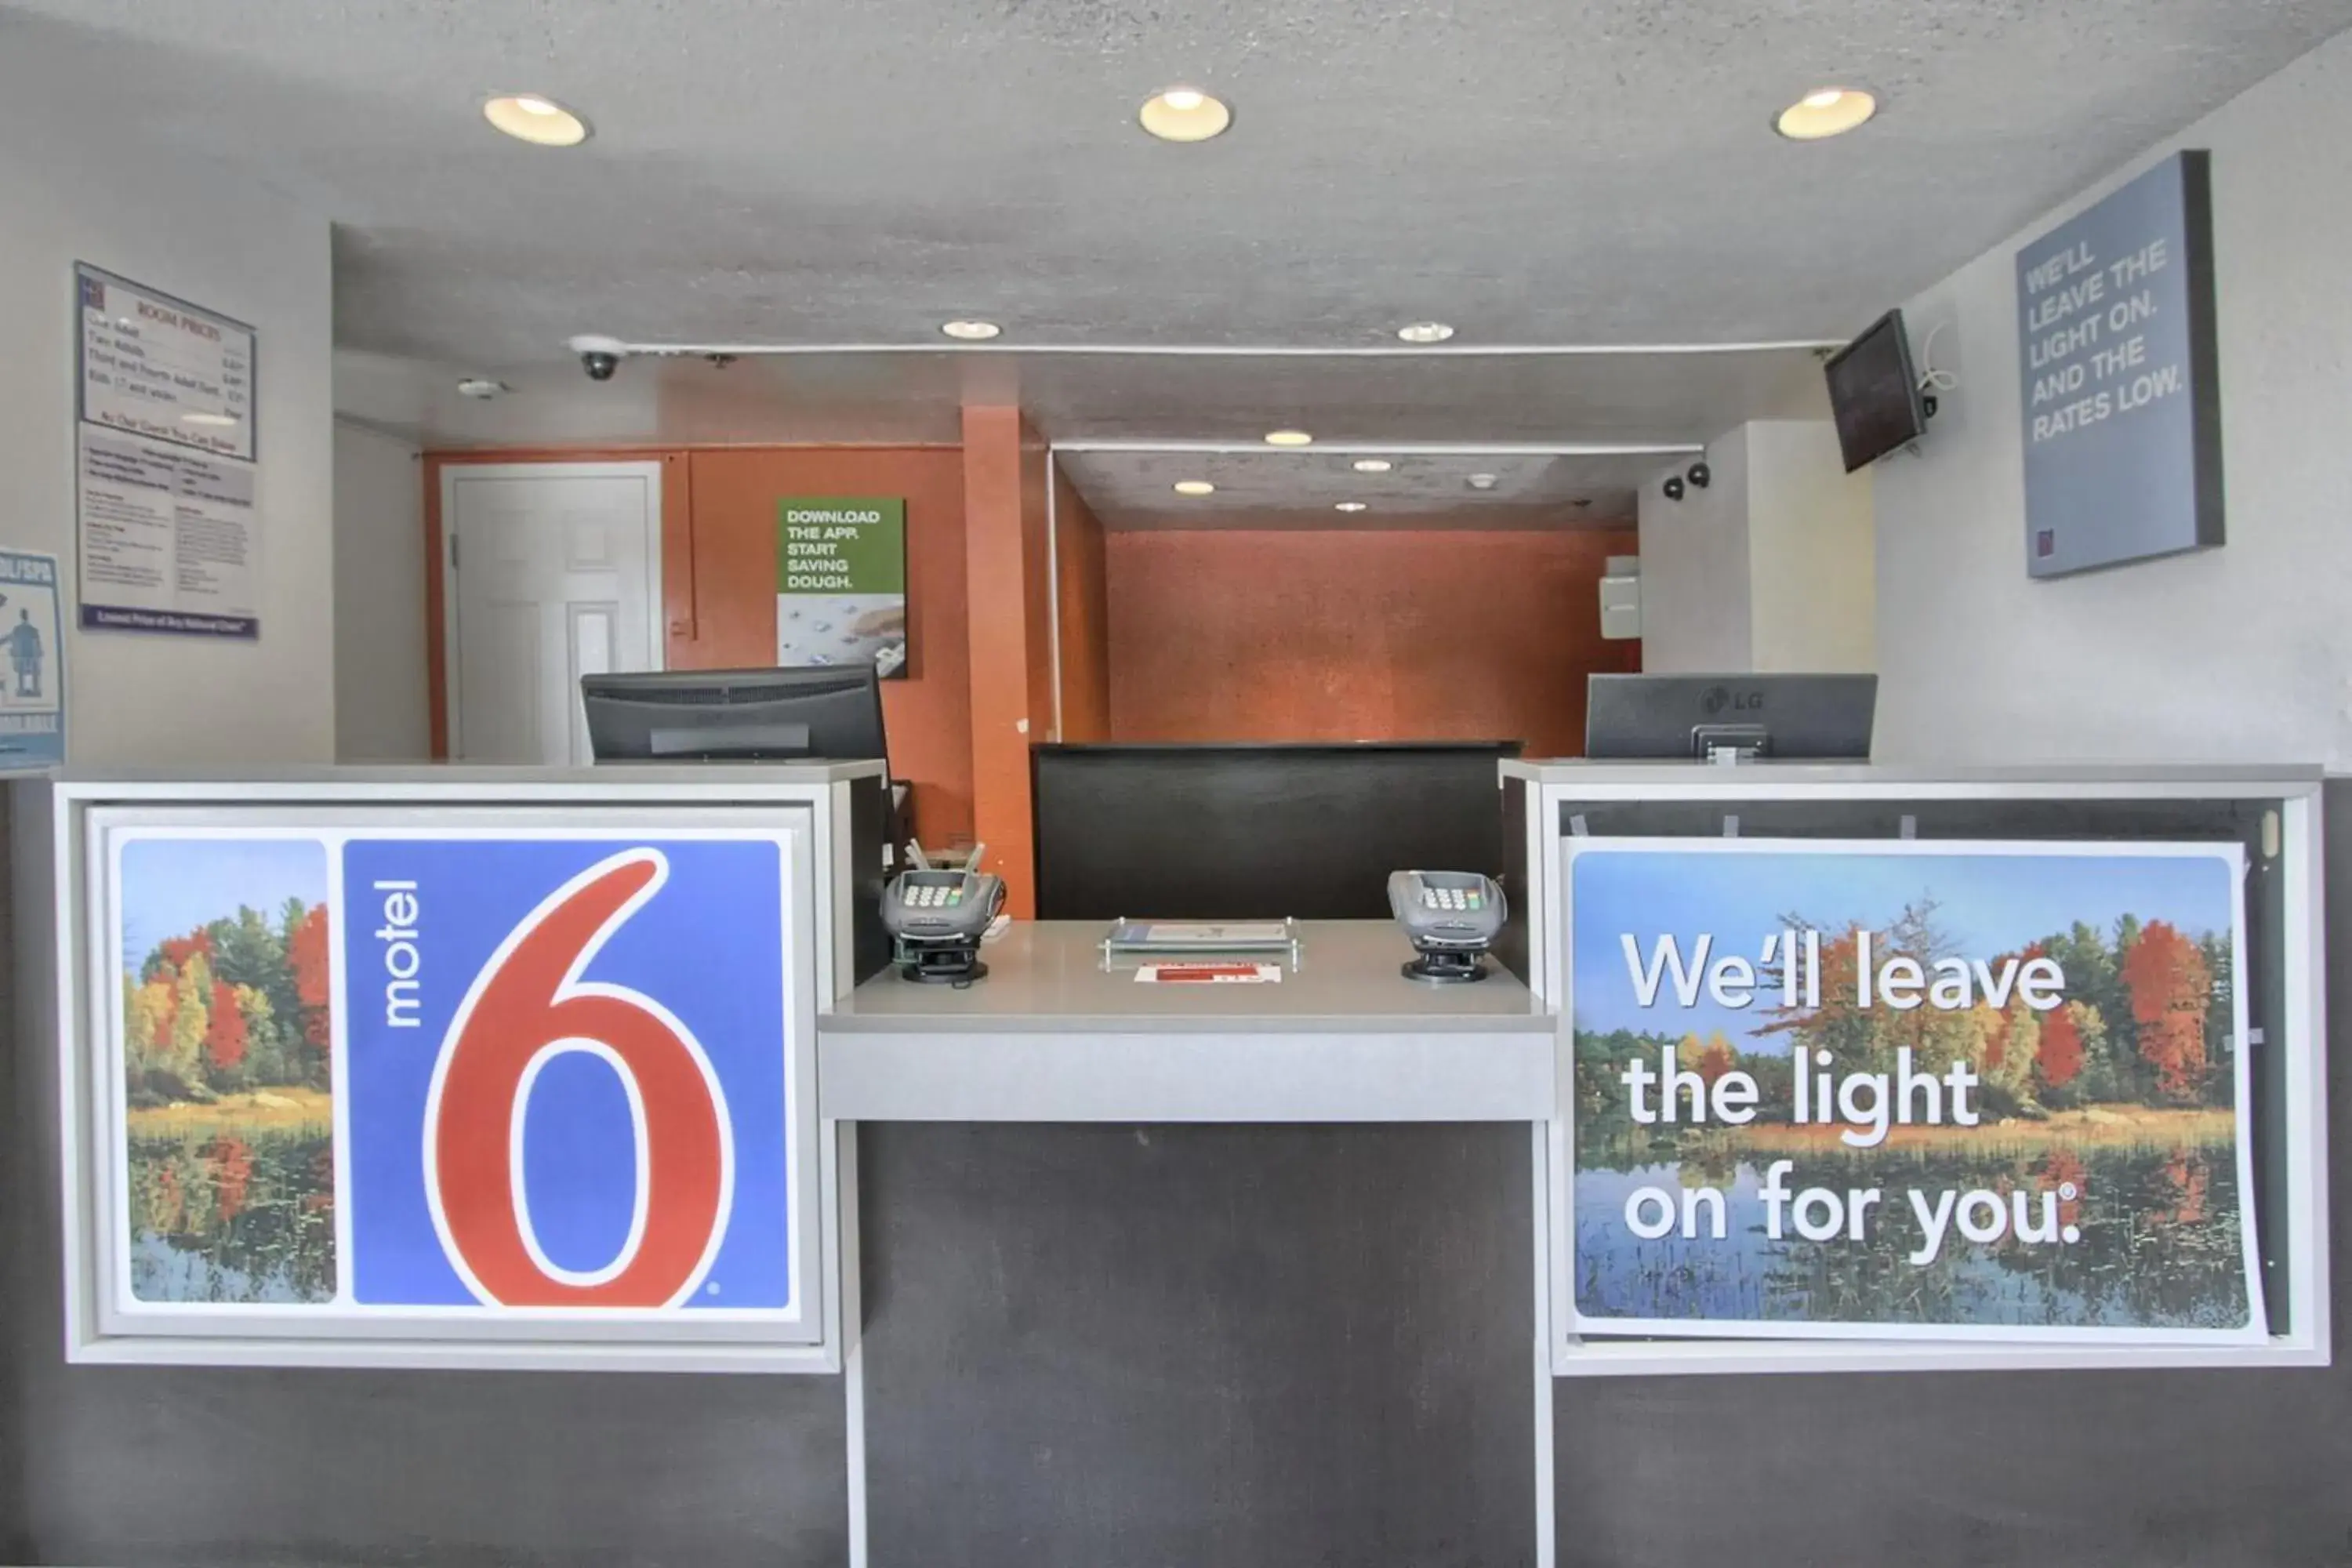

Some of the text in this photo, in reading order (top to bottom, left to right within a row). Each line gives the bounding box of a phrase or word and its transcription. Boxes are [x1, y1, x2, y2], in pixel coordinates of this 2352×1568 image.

[2029, 238, 2169, 333] LEAVE THE
[2029, 289, 2158, 369] LIGHT ON.
[2031, 335, 2146, 406] AND THE
[2032, 365, 2183, 442] RATES LOW.
[787, 510, 880, 523] DOWNLOAD
[787, 527, 860, 539] THE APP.
[787, 543, 837, 556] START
[787, 559, 849, 572] SAVING
[787, 575, 853, 588] DOUGH.
[1734, 691, 1765, 710] LG
[1621, 930, 2066, 1011] We'll leave
[374, 846, 736, 1308] motel 6
[1621, 1046, 1980, 1148] the light
[1624, 1186, 1726, 1241] on
[1758, 1160, 1881, 1242] for
